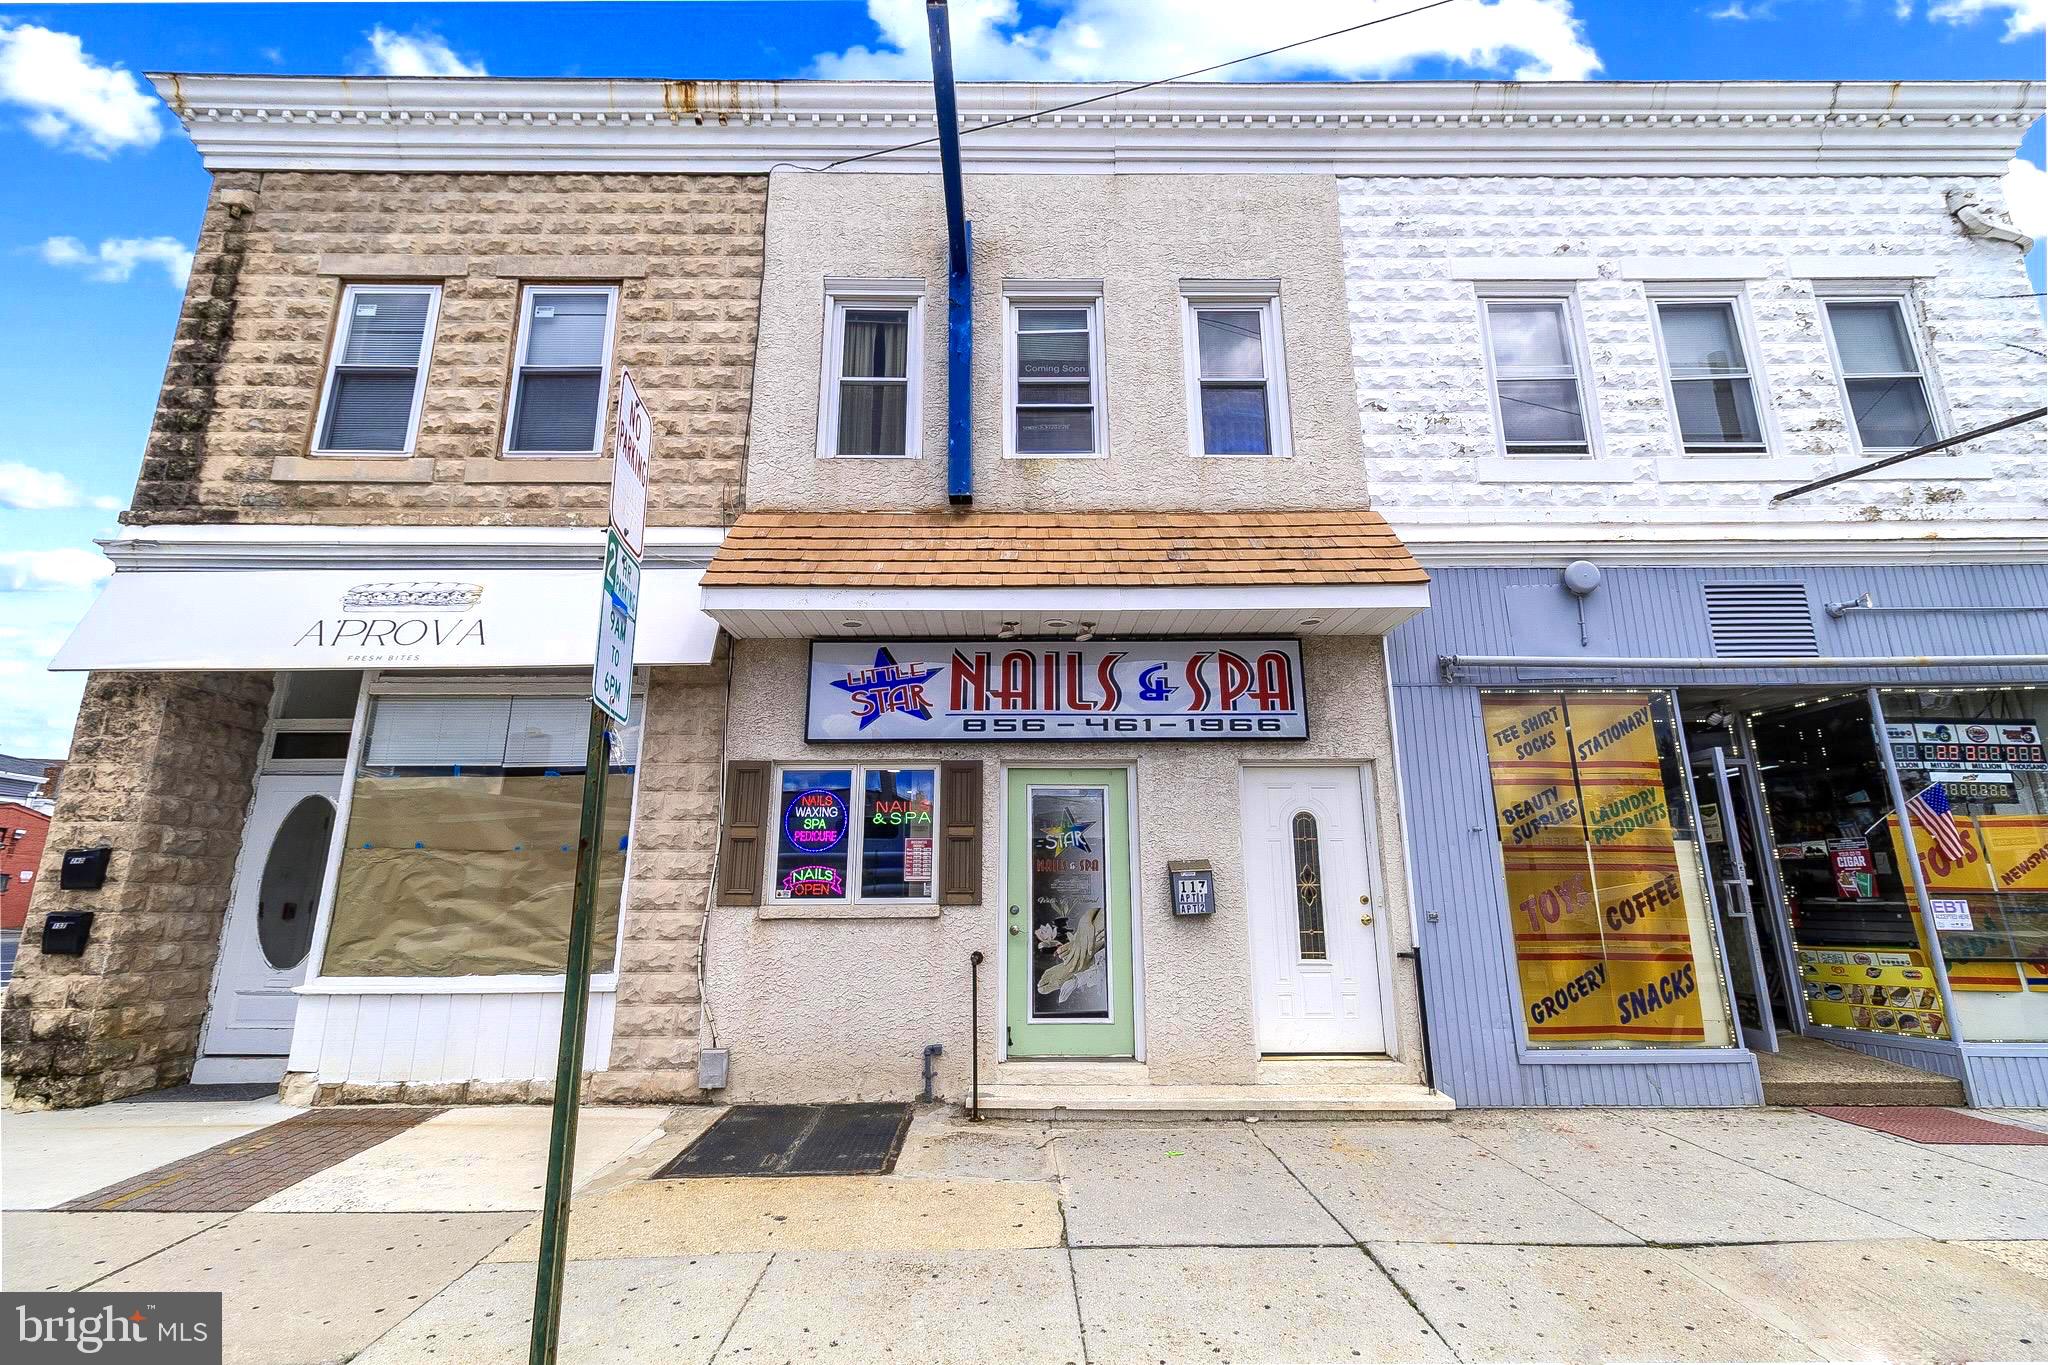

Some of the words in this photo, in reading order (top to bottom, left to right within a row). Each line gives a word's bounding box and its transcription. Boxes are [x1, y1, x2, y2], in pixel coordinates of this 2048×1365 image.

[1024, 364, 1060, 374] Coming
[1062, 364, 1086, 373] Soon
[629, 400, 642, 441] NO
[619, 418, 647, 488] PARKING
[606, 543, 617, 586] 2
[622, 561, 632, 585] HR
[614, 574, 636, 612] PARKING
[610, 610, 627, 644] 9AM
[611, 644, 620, 667] TO
[604, 671, 622, 702] 6PM
[846, 661, 928, 687] LITTLE
[949, 648, 1128, 711] NAILS
[1138, 662, 1179, 702] &
[1185, 648, 1296, 711] SPA
[850, 683, 934, 718] STAR
[1493, 724, 1521, 747] TEE
[1521, 706, 1559, 736] SHIRT
[1577, 706, 1650, 761] STATIONARY
[1515, 730, 1557, 761] SOCKS
[795, 806, 838, 817] WAXING
[801, 795, 833, 806] NAILS
[875, 799, 931, 813] NAILS
[1502, 785, 1559, 826] BEAUTY
[1589, 786, 1657, 825] LAUNDRY
[794, 830, 838, 842] PEDICURE
[803, 818, 827, 829] SPA
[1512, 799, 1578, 845] SUPPLIES
[1591, 802, 1667, 845] PRODUCTS
[1045, 830, 1086, 850] STAR
[1080, 859, 1099, 872] SPA
[1836, 855, 1867, 868] CIGAR
[1919, 829, 1978, 885] TOS
[2000, 844, 2048, 886] NEWSPA
[793, 868, 834, 883] NAILS
[795, 883, 829, 895] OPEN
[1181, 880, 1206, 893] 117
[1180, 893, 1197, 902] APT
[1181, 904, 1197, 914] APT
[1519, 871, 1590, 933] TOYS
[1605, 873, 1681, 931] COFFEE
[1931, 901, 1967, 913] EBT
[1530, 962, 1606, 1025] GROCERY
[1617, 963, 1696, 1025] SNACKS
